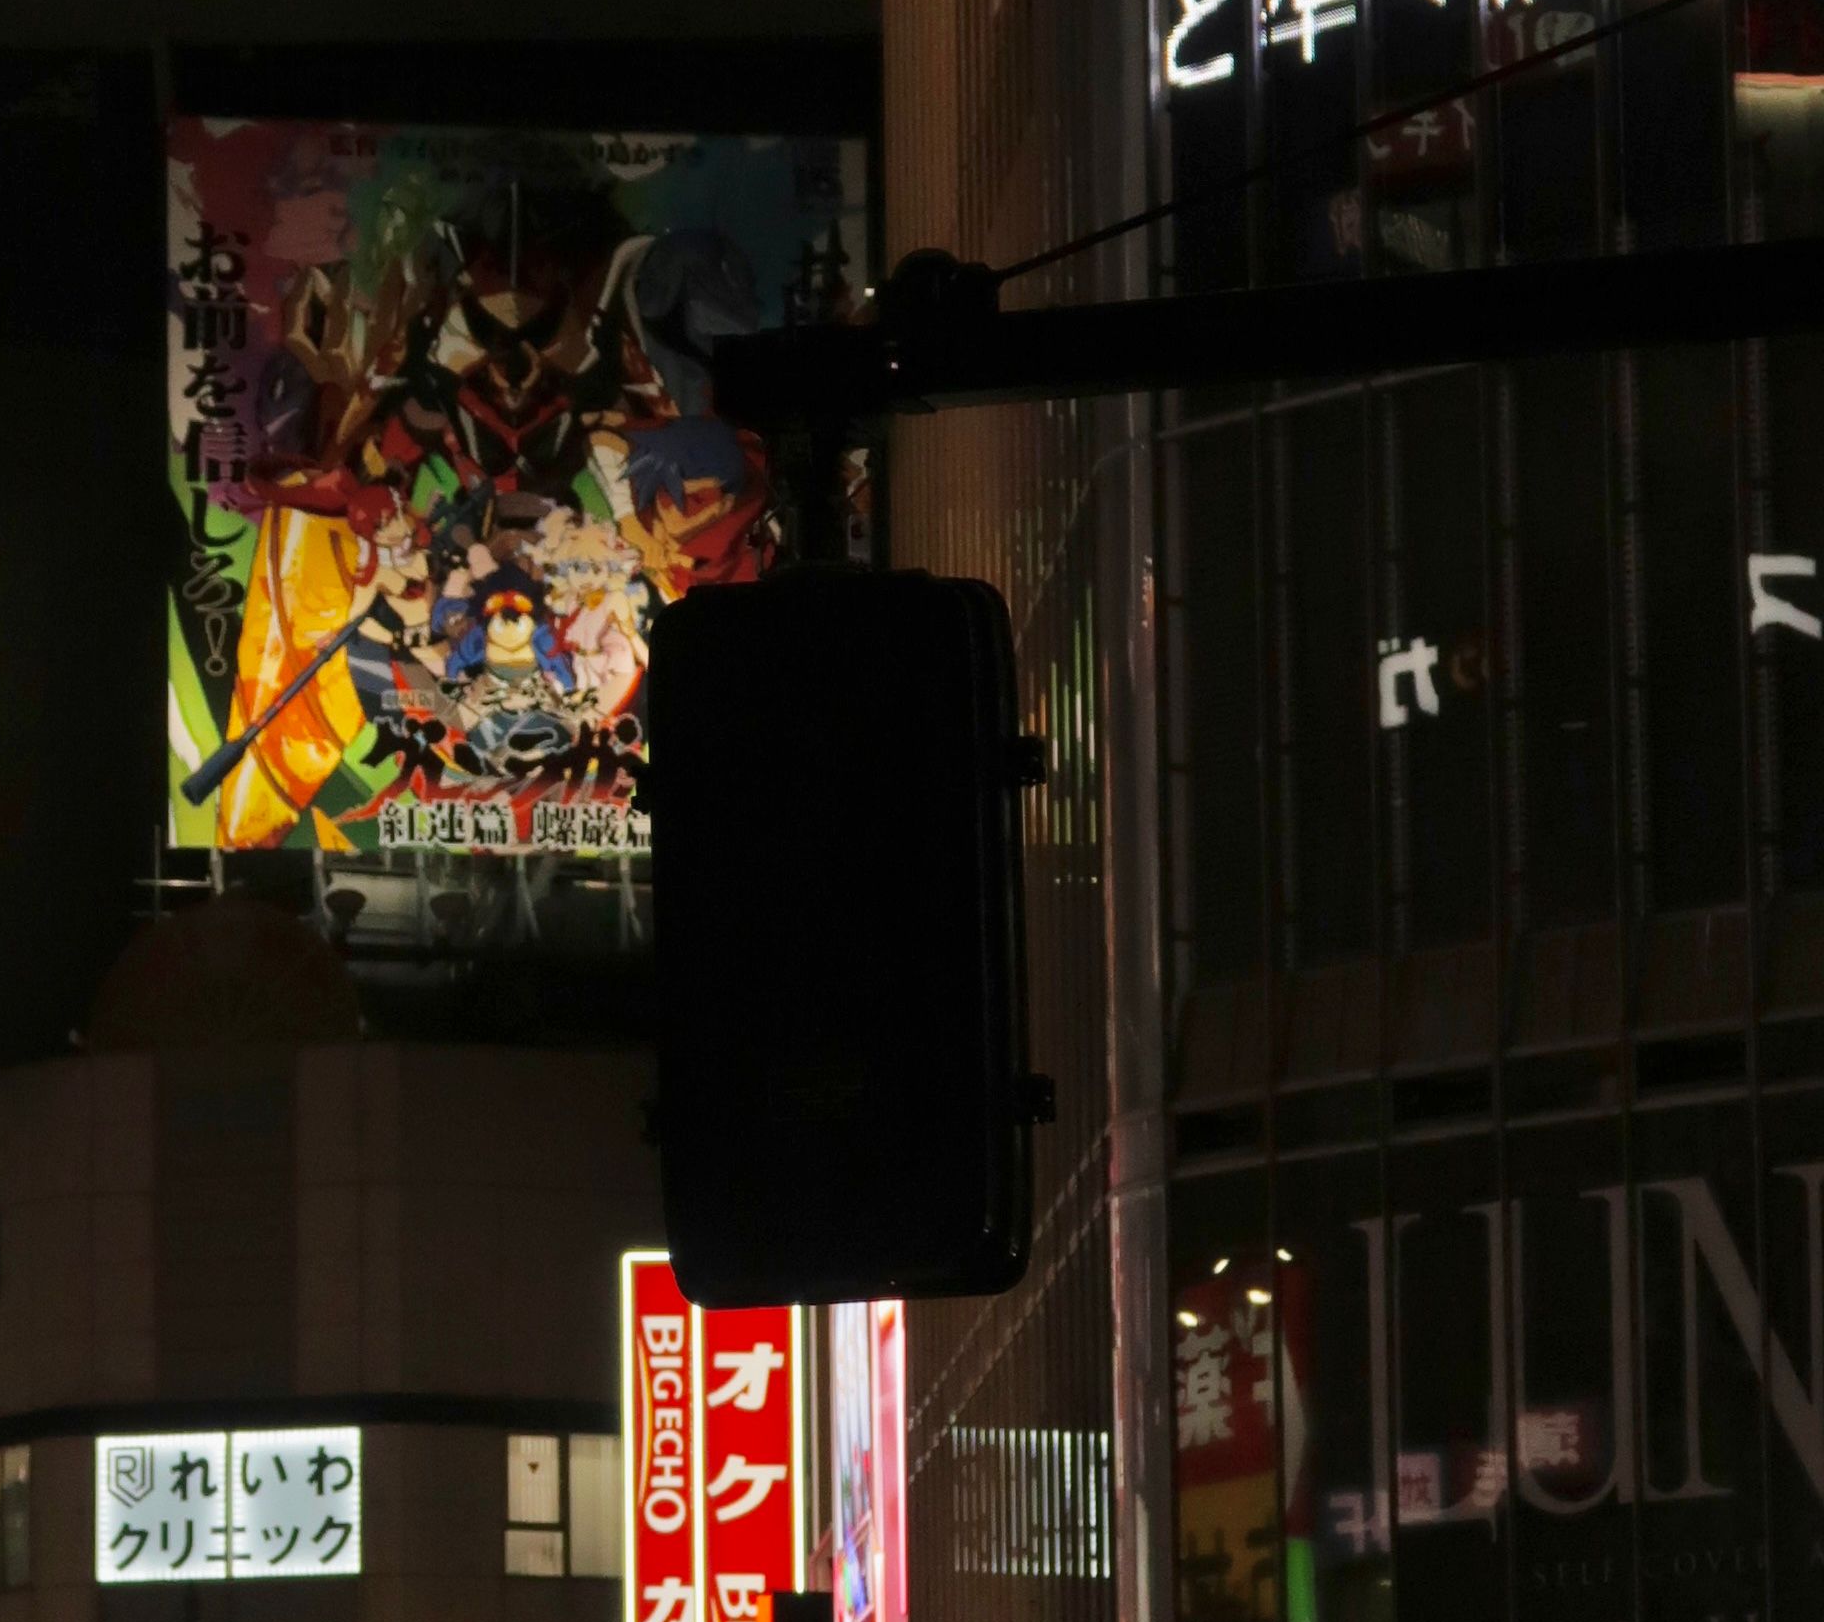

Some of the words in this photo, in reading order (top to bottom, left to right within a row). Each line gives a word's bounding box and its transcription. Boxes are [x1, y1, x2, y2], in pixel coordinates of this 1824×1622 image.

[641, 1314, 685, 1400] BIG
[170, 1445, 354, 1501] れいわ
[643, 1408, 688, 1534] ECHO
[706, 1342, 788, 1523] オケ
[109, 1516, 354, 1571] クリニック
